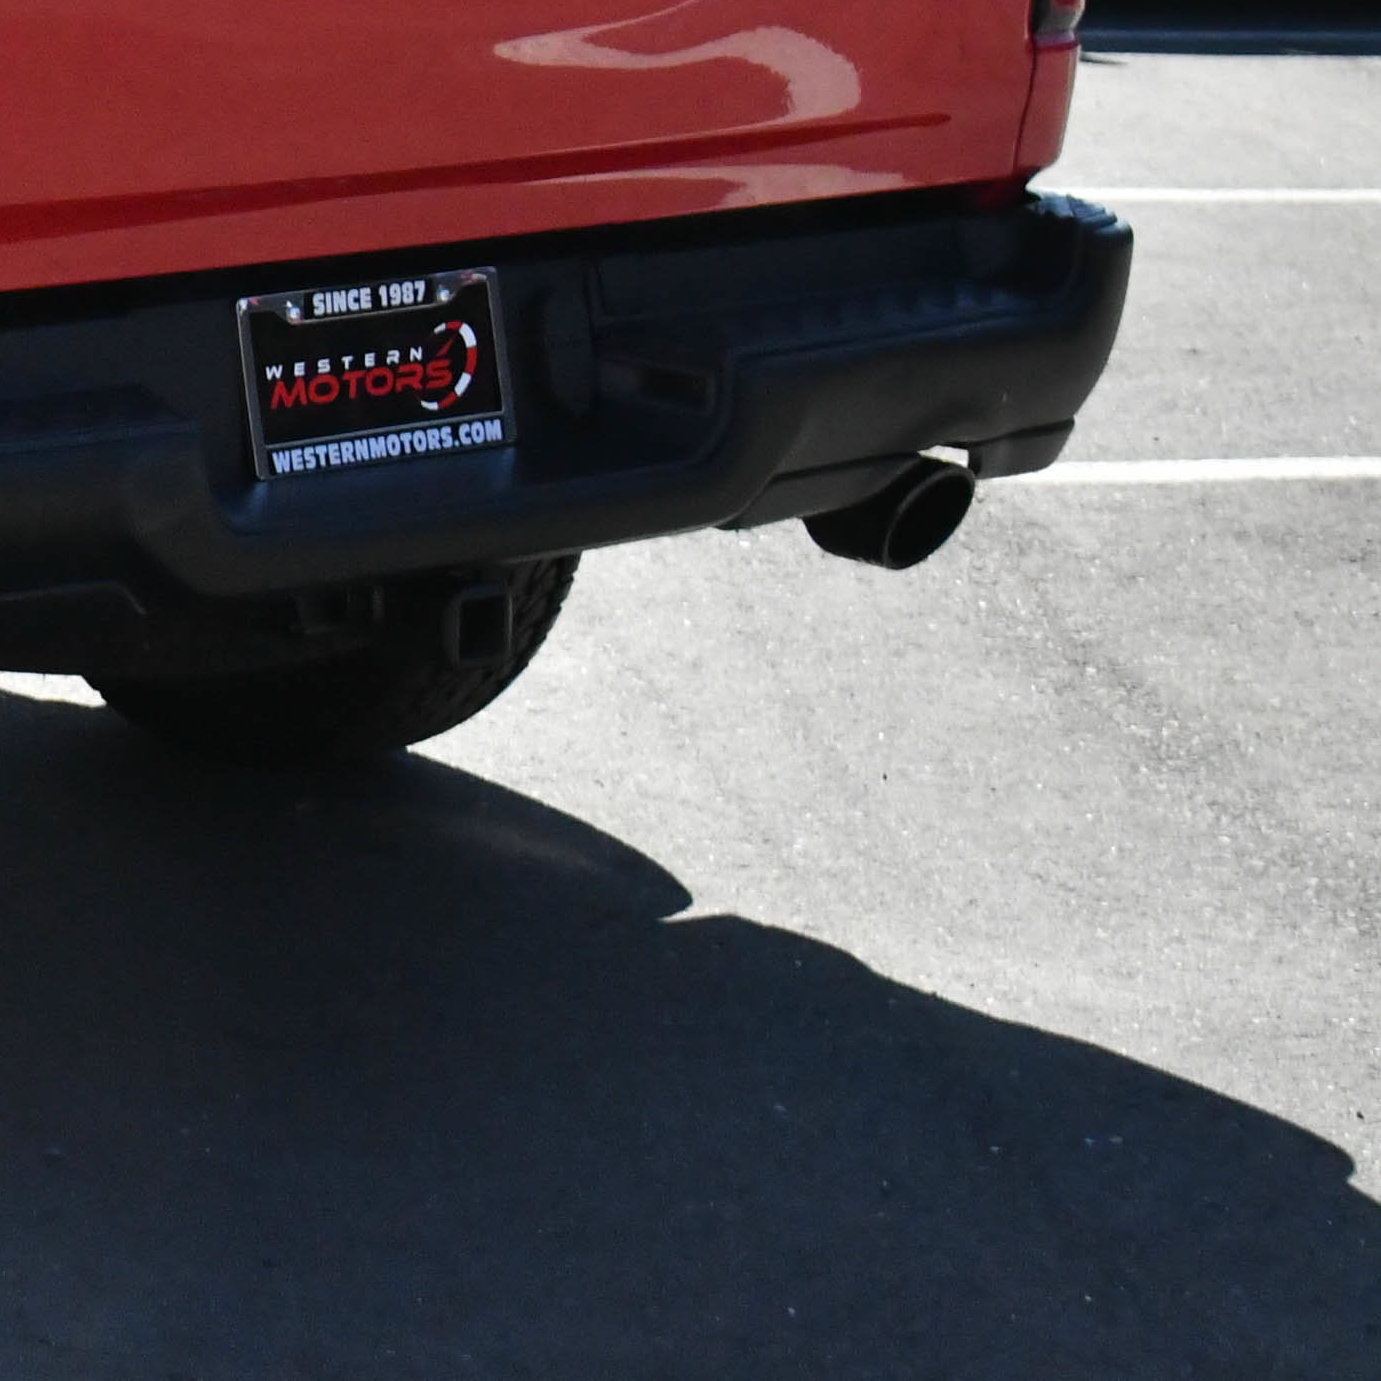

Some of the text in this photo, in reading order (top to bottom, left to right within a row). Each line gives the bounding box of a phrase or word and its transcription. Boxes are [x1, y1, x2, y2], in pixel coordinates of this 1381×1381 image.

[313, 280, 426, 316] SINCE 1987
[266, 347, 423, 381] WESTERN
[271, 360, 452, 410] MOTORS
[272, 419, 503, 474] WESTERNMOTORS.COM
